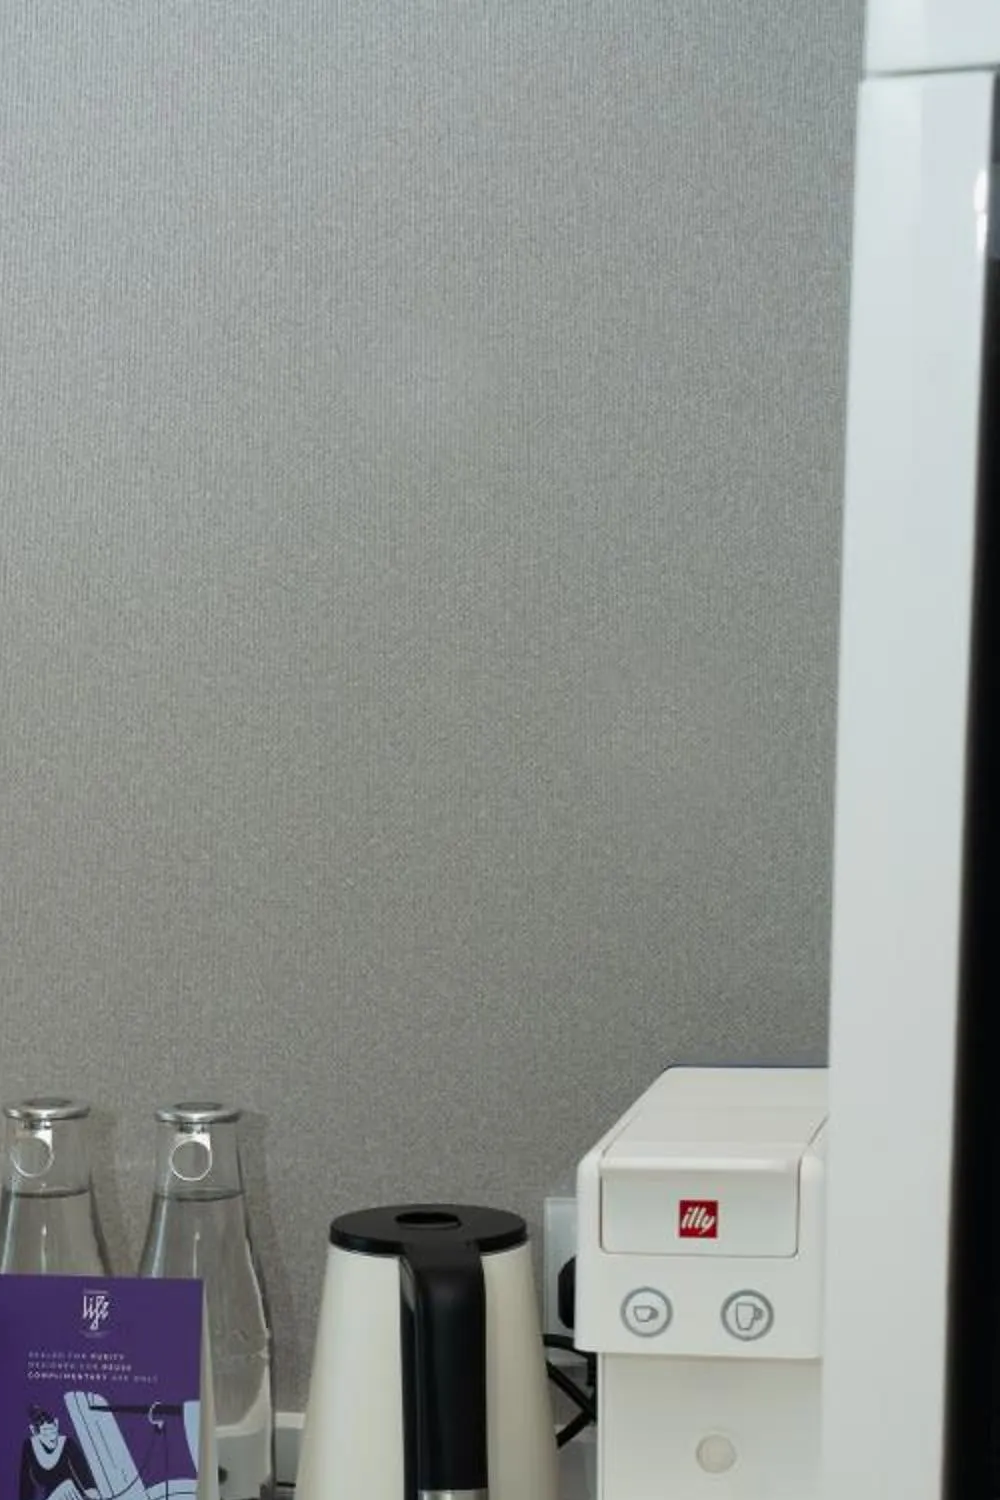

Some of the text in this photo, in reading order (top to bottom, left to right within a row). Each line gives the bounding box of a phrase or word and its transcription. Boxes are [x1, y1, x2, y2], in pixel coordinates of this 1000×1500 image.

[681, 1207, 715, 1234] illy
[90, 1353, 125, 1361] PURITY
[27, 1371, 107, 1380] COMPLIMENTARY
